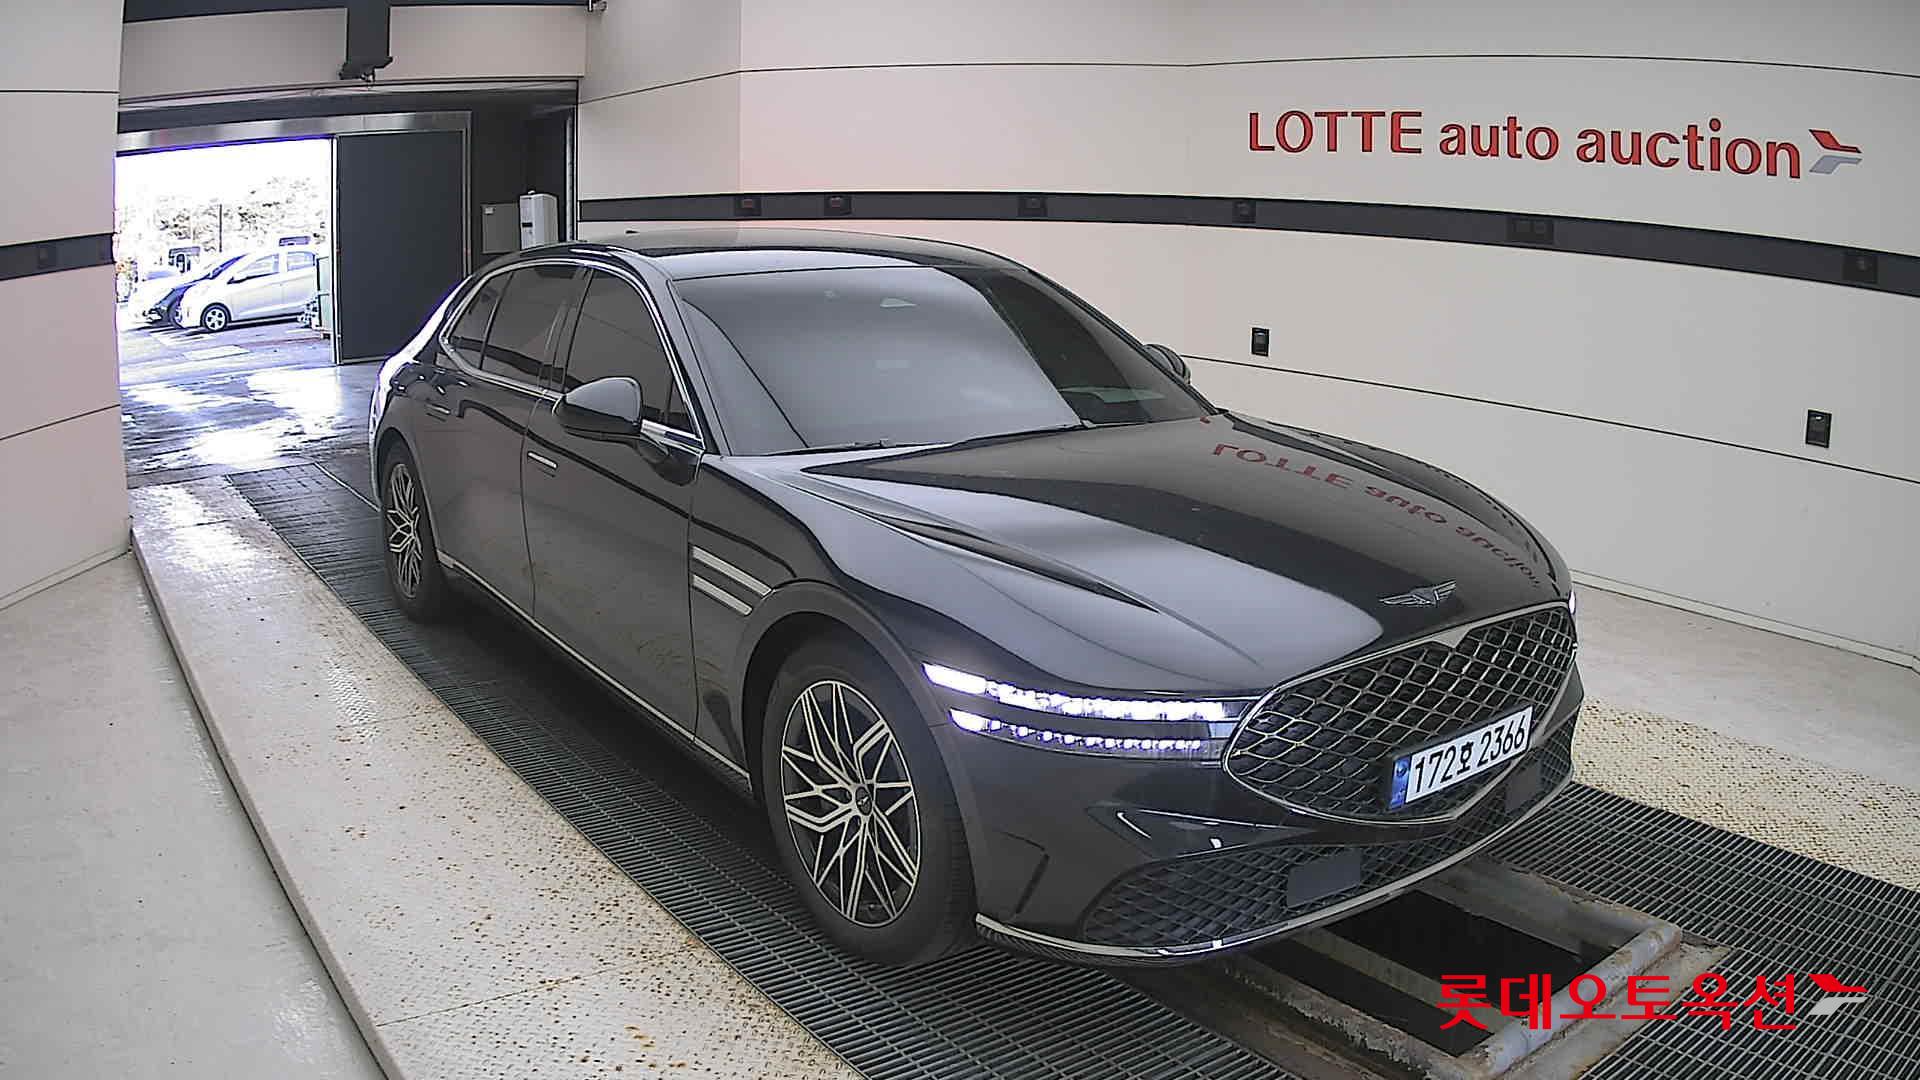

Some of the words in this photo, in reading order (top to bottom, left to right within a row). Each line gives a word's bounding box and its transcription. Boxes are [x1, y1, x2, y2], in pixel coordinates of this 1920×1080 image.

[1248, 111, 1423, 154] LOTTE
[1439, 116, 1560, 161] auto
[1576, 117, 1801, 179] auction
[1415, 741, 1474, 793] 172호
[1477, 715, 1526, 767] 2366
